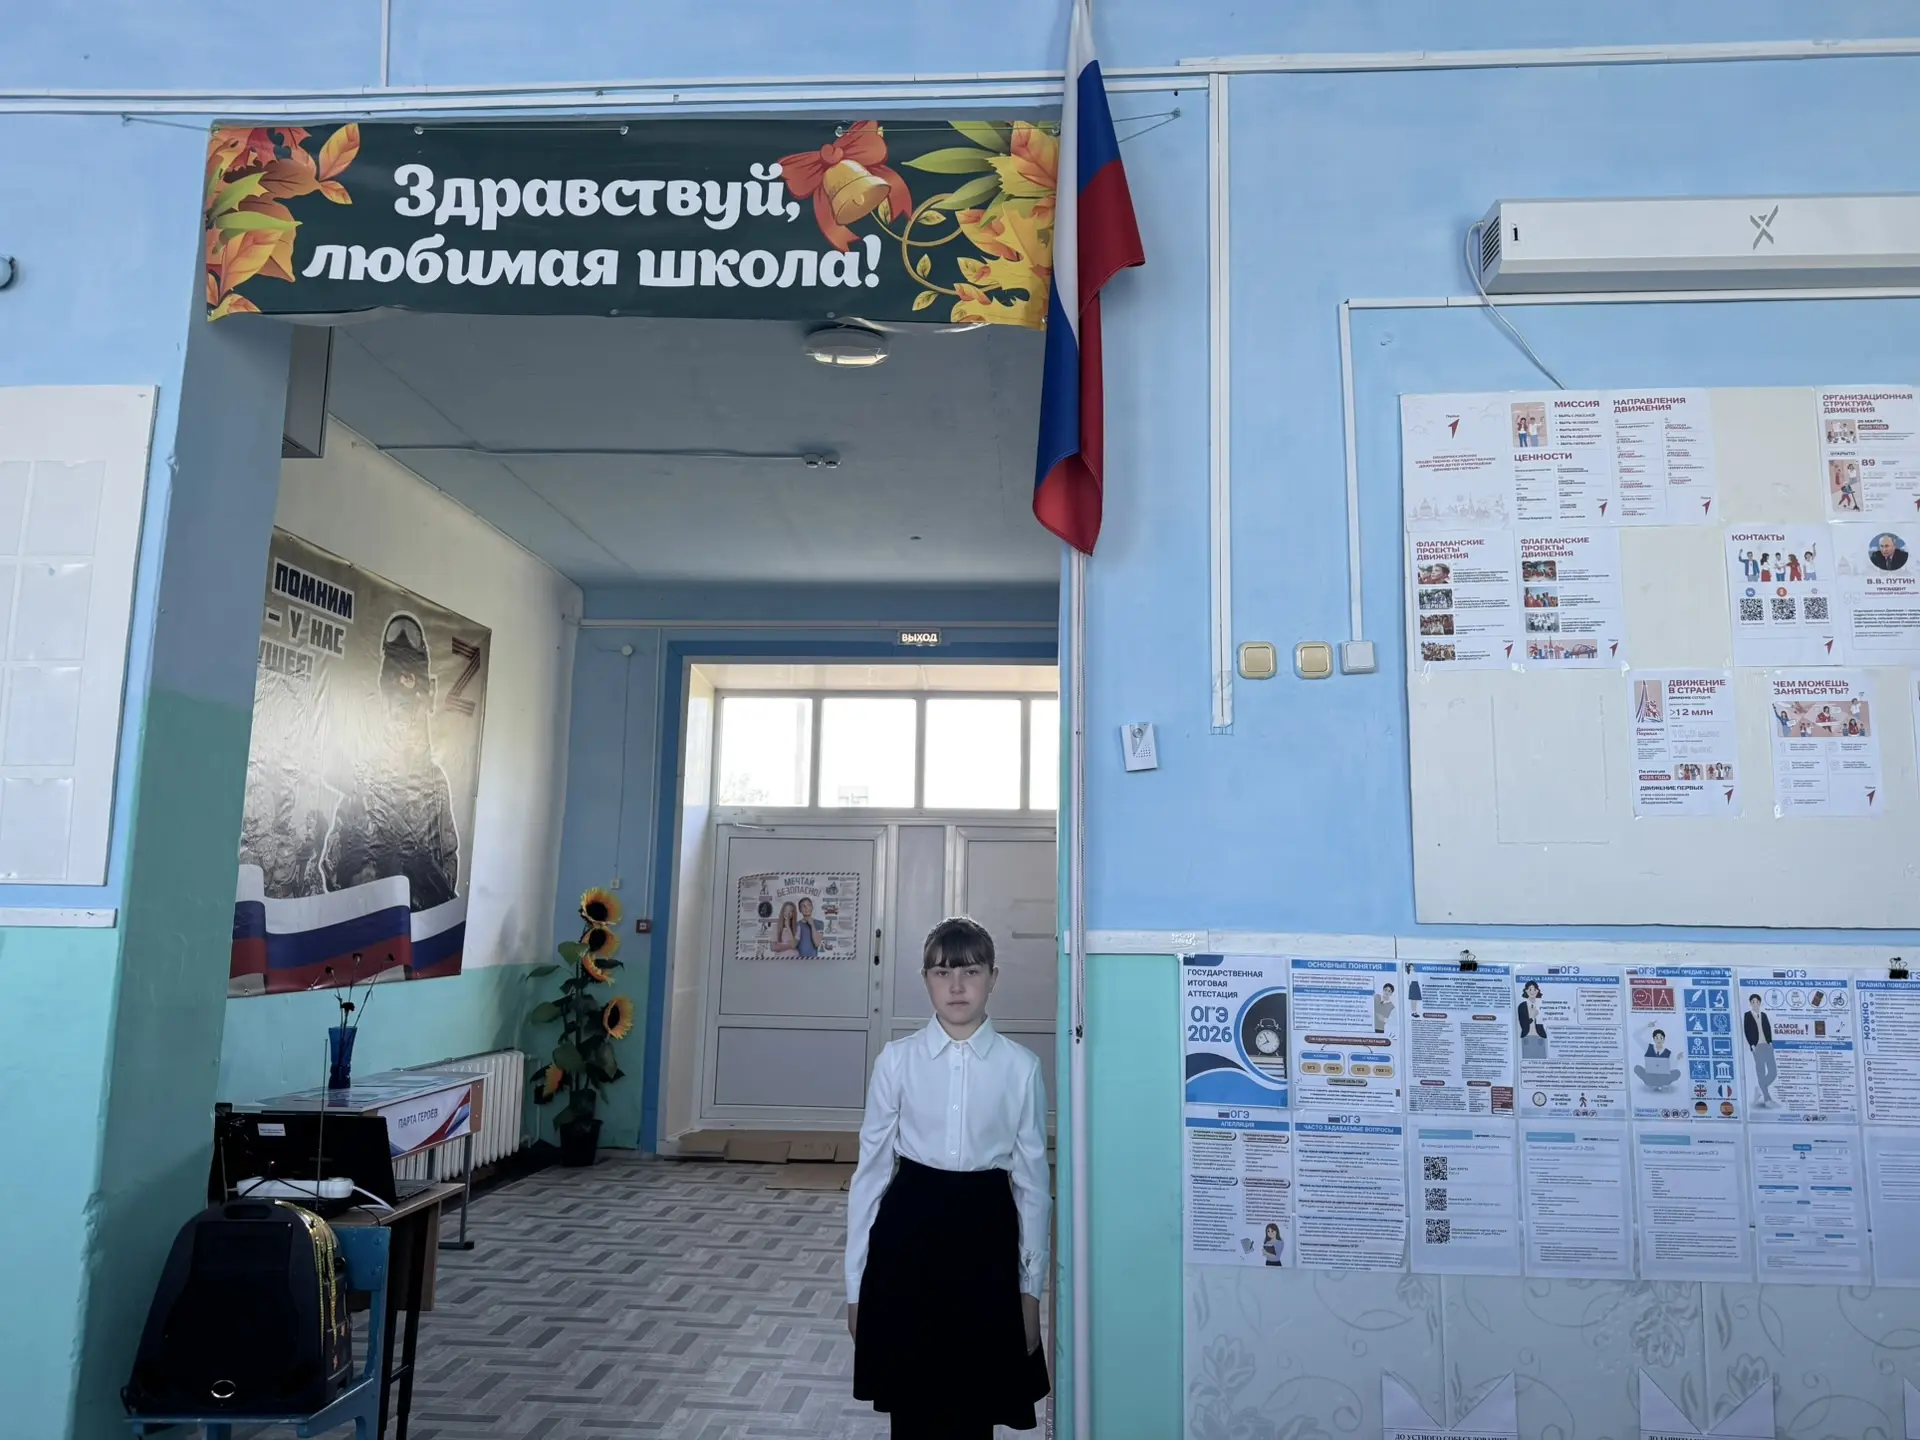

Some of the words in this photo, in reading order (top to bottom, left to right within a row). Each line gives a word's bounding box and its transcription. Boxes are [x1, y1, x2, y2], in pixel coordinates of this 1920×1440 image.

[393, 162, 801, 231] Здравствуй,
[301, 236, 618, 288] любимая
[638, 235, 882, 288] школа!
[1554, 400, 1600, 408] МИССИЯ
[1613, 397, 1686, 406] НАПРАВЛЕНИЯ
[1613, 405, 1672, 413] ДВИЖЕНИЯ
[1514, 453, 1573, 462] ЦЕННОСТИ
[1861, 459, 1876, 467] 89
[1416, 539, 1485, 547] ФЛАГМАНСКИЕ
[1520, 537, 1590, 545] ФЛАГМАНСКИЕ
[1417, 553, 1469, 561] ДВИЖЕНИЯ
[275, 561, 353, 620] ПОМНИМ
[289, 610, 303, 638] У
[310, 620, 345, 654] НАС
[901, 633, 938, 642] ВЫХОД
[1668, 679, 1726, 687] ДВИЖЕНИЕ
[1677, 686, 1717, 694] СТРАНЕ
[1773, 687, 1828, 695] ЗАНЯТЬСЯ
[1828, 687, 1849, 695] ТЫ?
[784, 876, 815, 886] МЕЧТАЙ
[776, 885, 822, 898] БЕЗОПАСНО!
[1307, 961, 1347, 969] ОСНОВНЫЕ
[1348, 962, 1382, 970] ПОНЯТИЯ
[1560, 966, 1580, 974] ОГЭ
[1187, 968, 1263, 978] ГОСУДАРСТВЕННАЯ
[1639, 967, 1655, 975] ОГЭ
[1786, 969, 1807, 978] ОГЭ
[1187, 979, 1228, 988] ИТОГОВАЯ
[1187, 990, 1238, 999] АТТЕСТАЦИЯ
[1190, 1005, 1229, 1023] ОГЭ
[1862, 1002, 1871, 1040] МОЖНО
[1187, 1025, 1233, 1043] 2026
[398, 1115, 417, 1129] ПАРТА
[417, 1107, 439, 1122] ГЕРОЕВ
[1230, 1110, 1250, 1118] ОГЭ
[1340, 1115, 1361, 1123] ОГЭ
